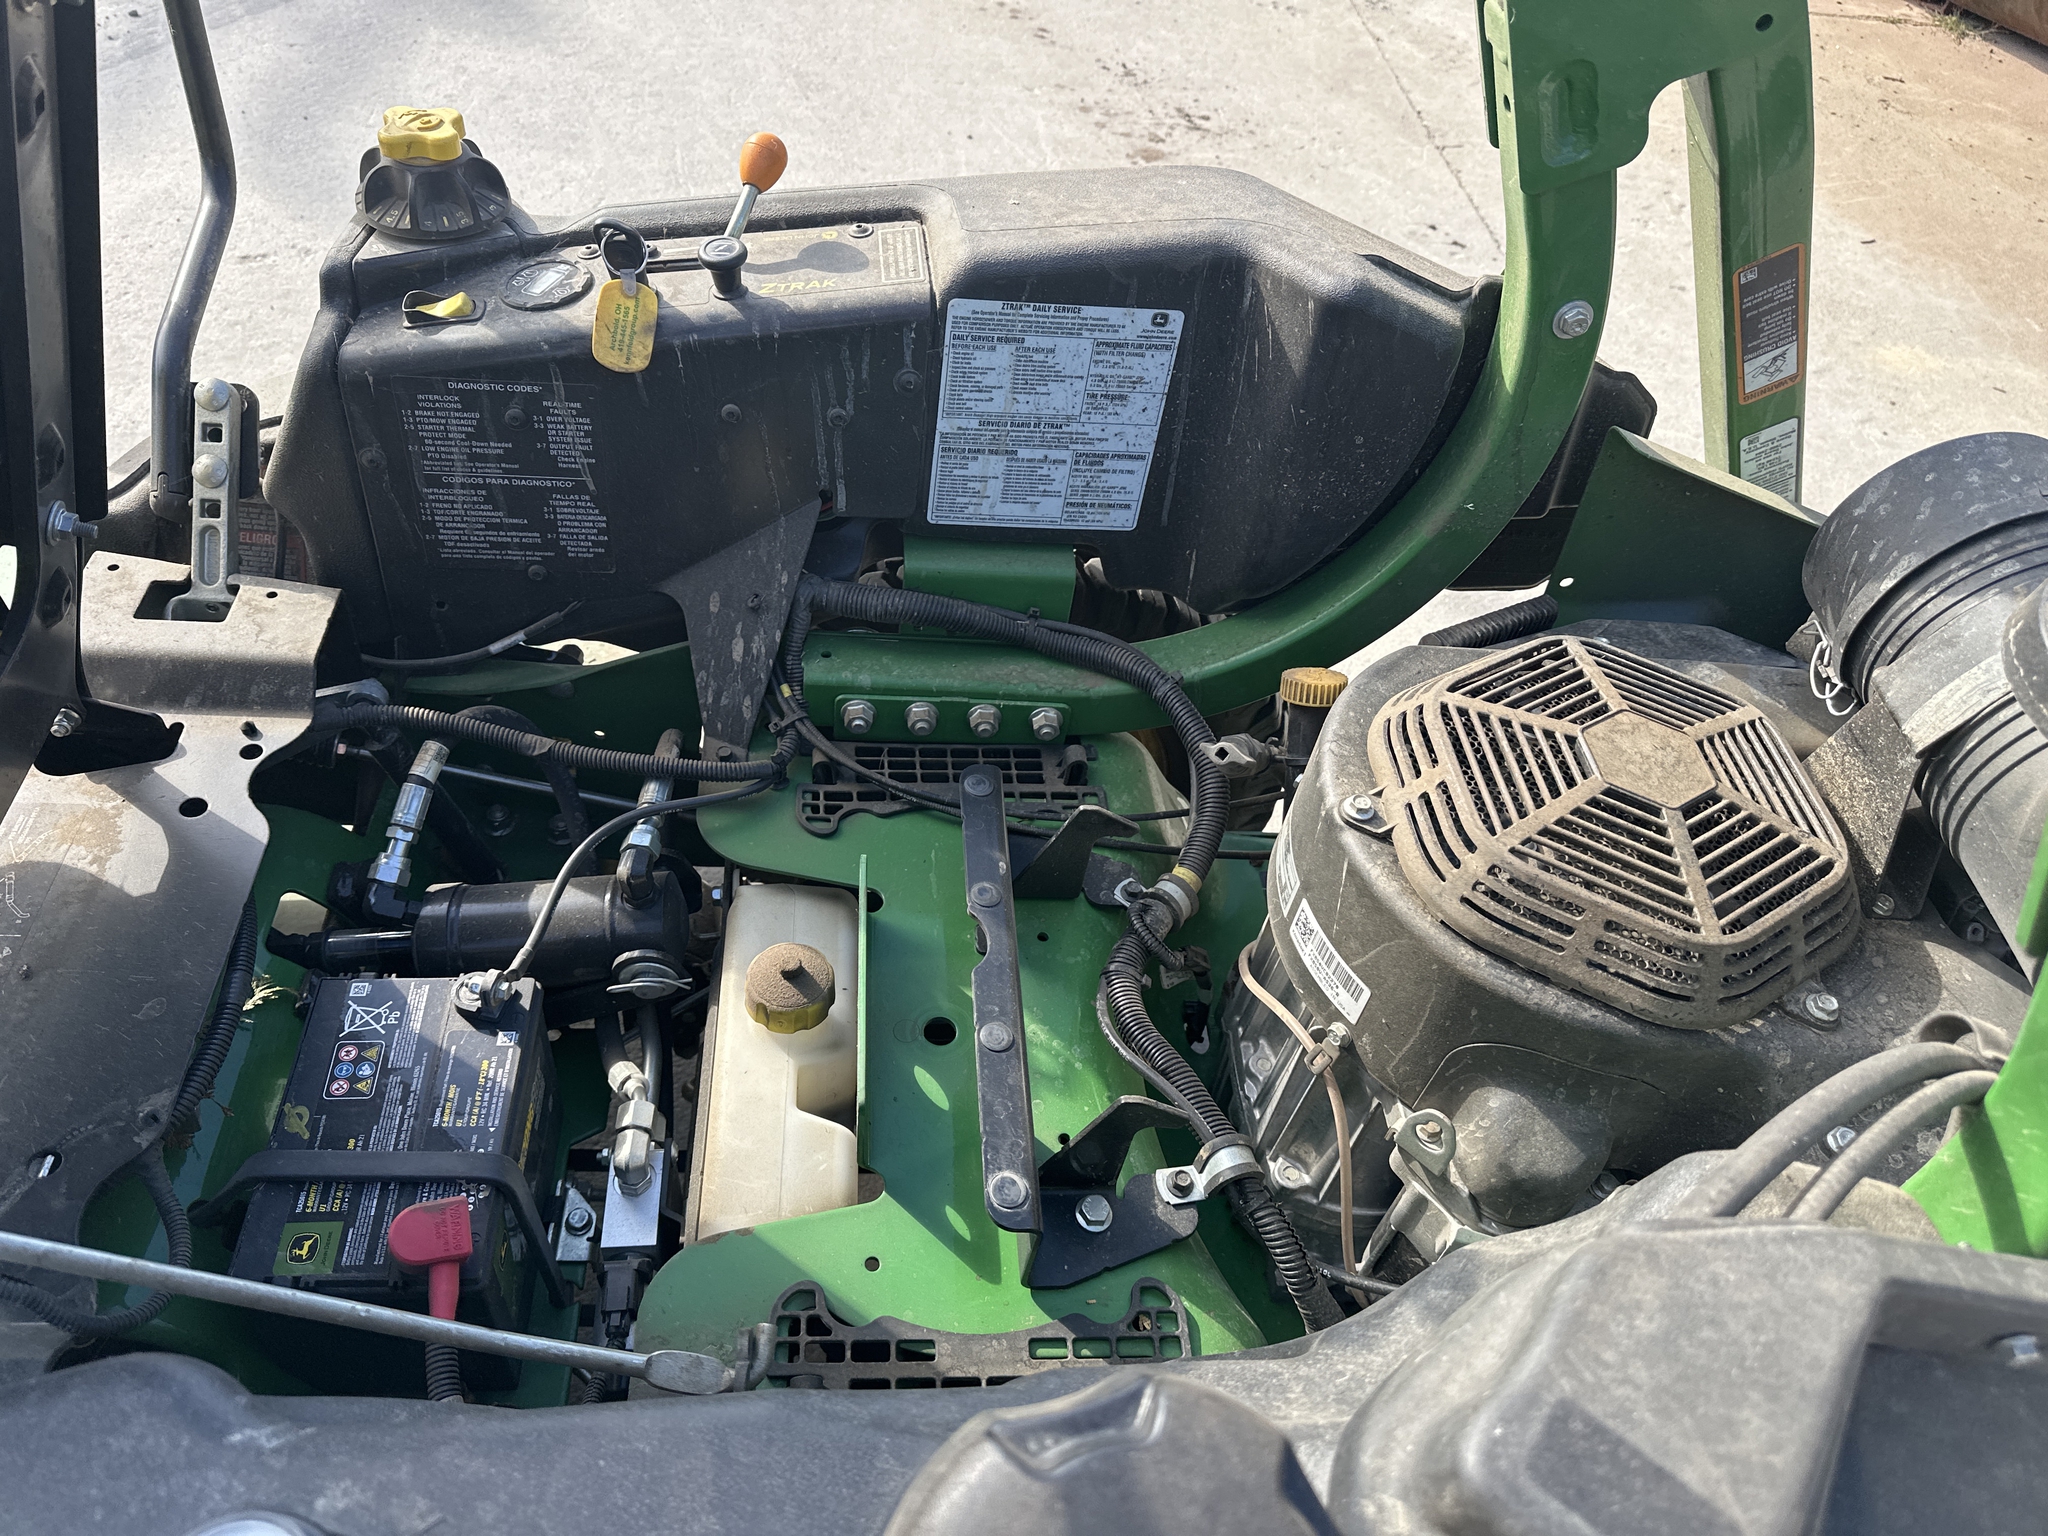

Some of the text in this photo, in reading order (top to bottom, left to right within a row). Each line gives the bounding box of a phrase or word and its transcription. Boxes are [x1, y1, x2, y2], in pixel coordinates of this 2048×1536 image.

[759, 278, 837, 293] ZTRAK
[1053, 306, 1081, 314] SERVICE
[610, 304, 622, 351] Archbold, OH
[618, 306, 630, 352] 419-445-1565
[1744, 335, 1797, 361] AVOID CRUSHING
[448, 382, 504, 391] DIAGNOSTIC
[1744, 380, 1788, 402] WARNING
[240, 532, 278, 545] ELIGRO
[387, 1011, 400, 1025] Pb
[347, 1138, 356, 1150] 300
[306, 1184, 318, 1212] 6-MONTH
[319, 1204, 326, 1212] U1
[450, 1204, 463, 1250] WARNING
